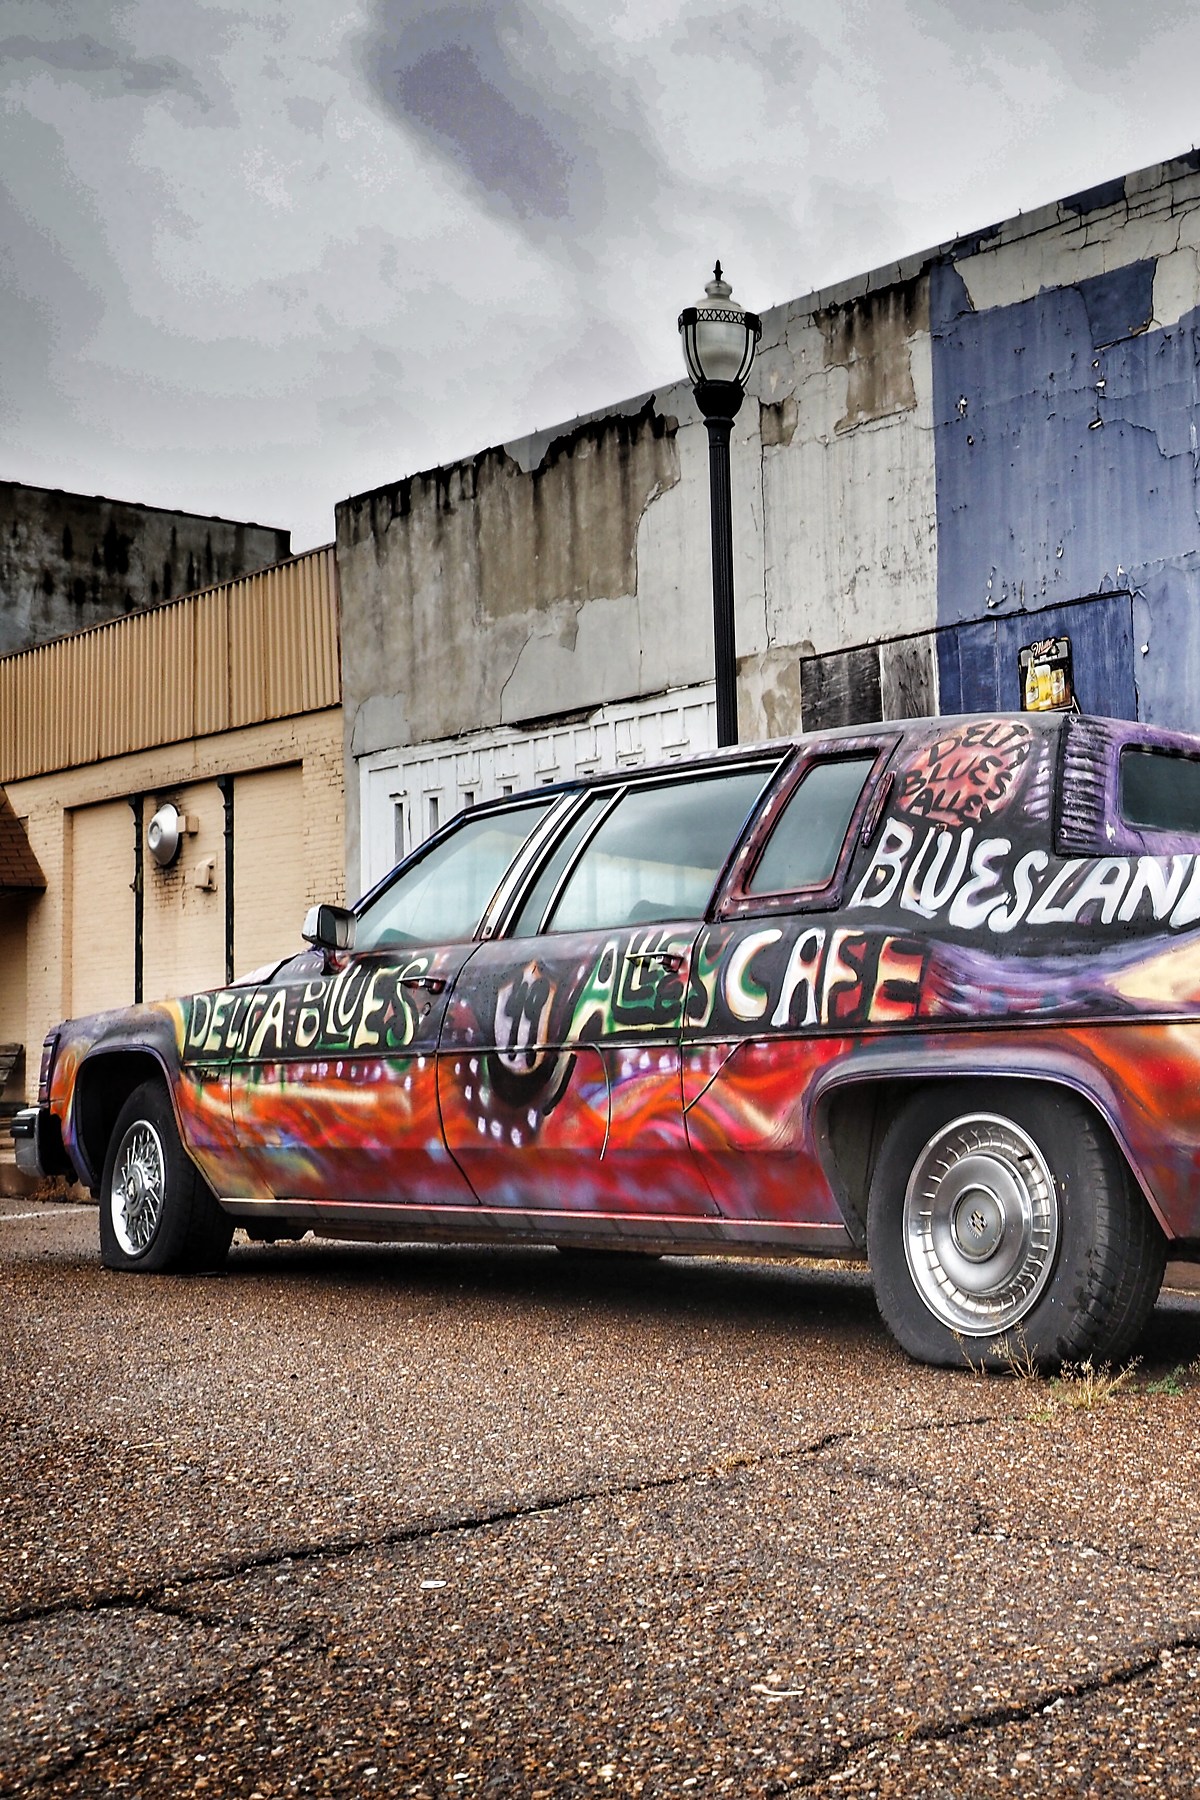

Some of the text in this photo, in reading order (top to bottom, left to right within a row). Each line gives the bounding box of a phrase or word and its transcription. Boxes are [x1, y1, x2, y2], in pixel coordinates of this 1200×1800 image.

[904, 756, 1013, 800] BLUES
[188, 988, 287, 1058] DELTA
[294, 956, 429, 1051] BLUES
[724, 928, 926, 1028] CAFE
